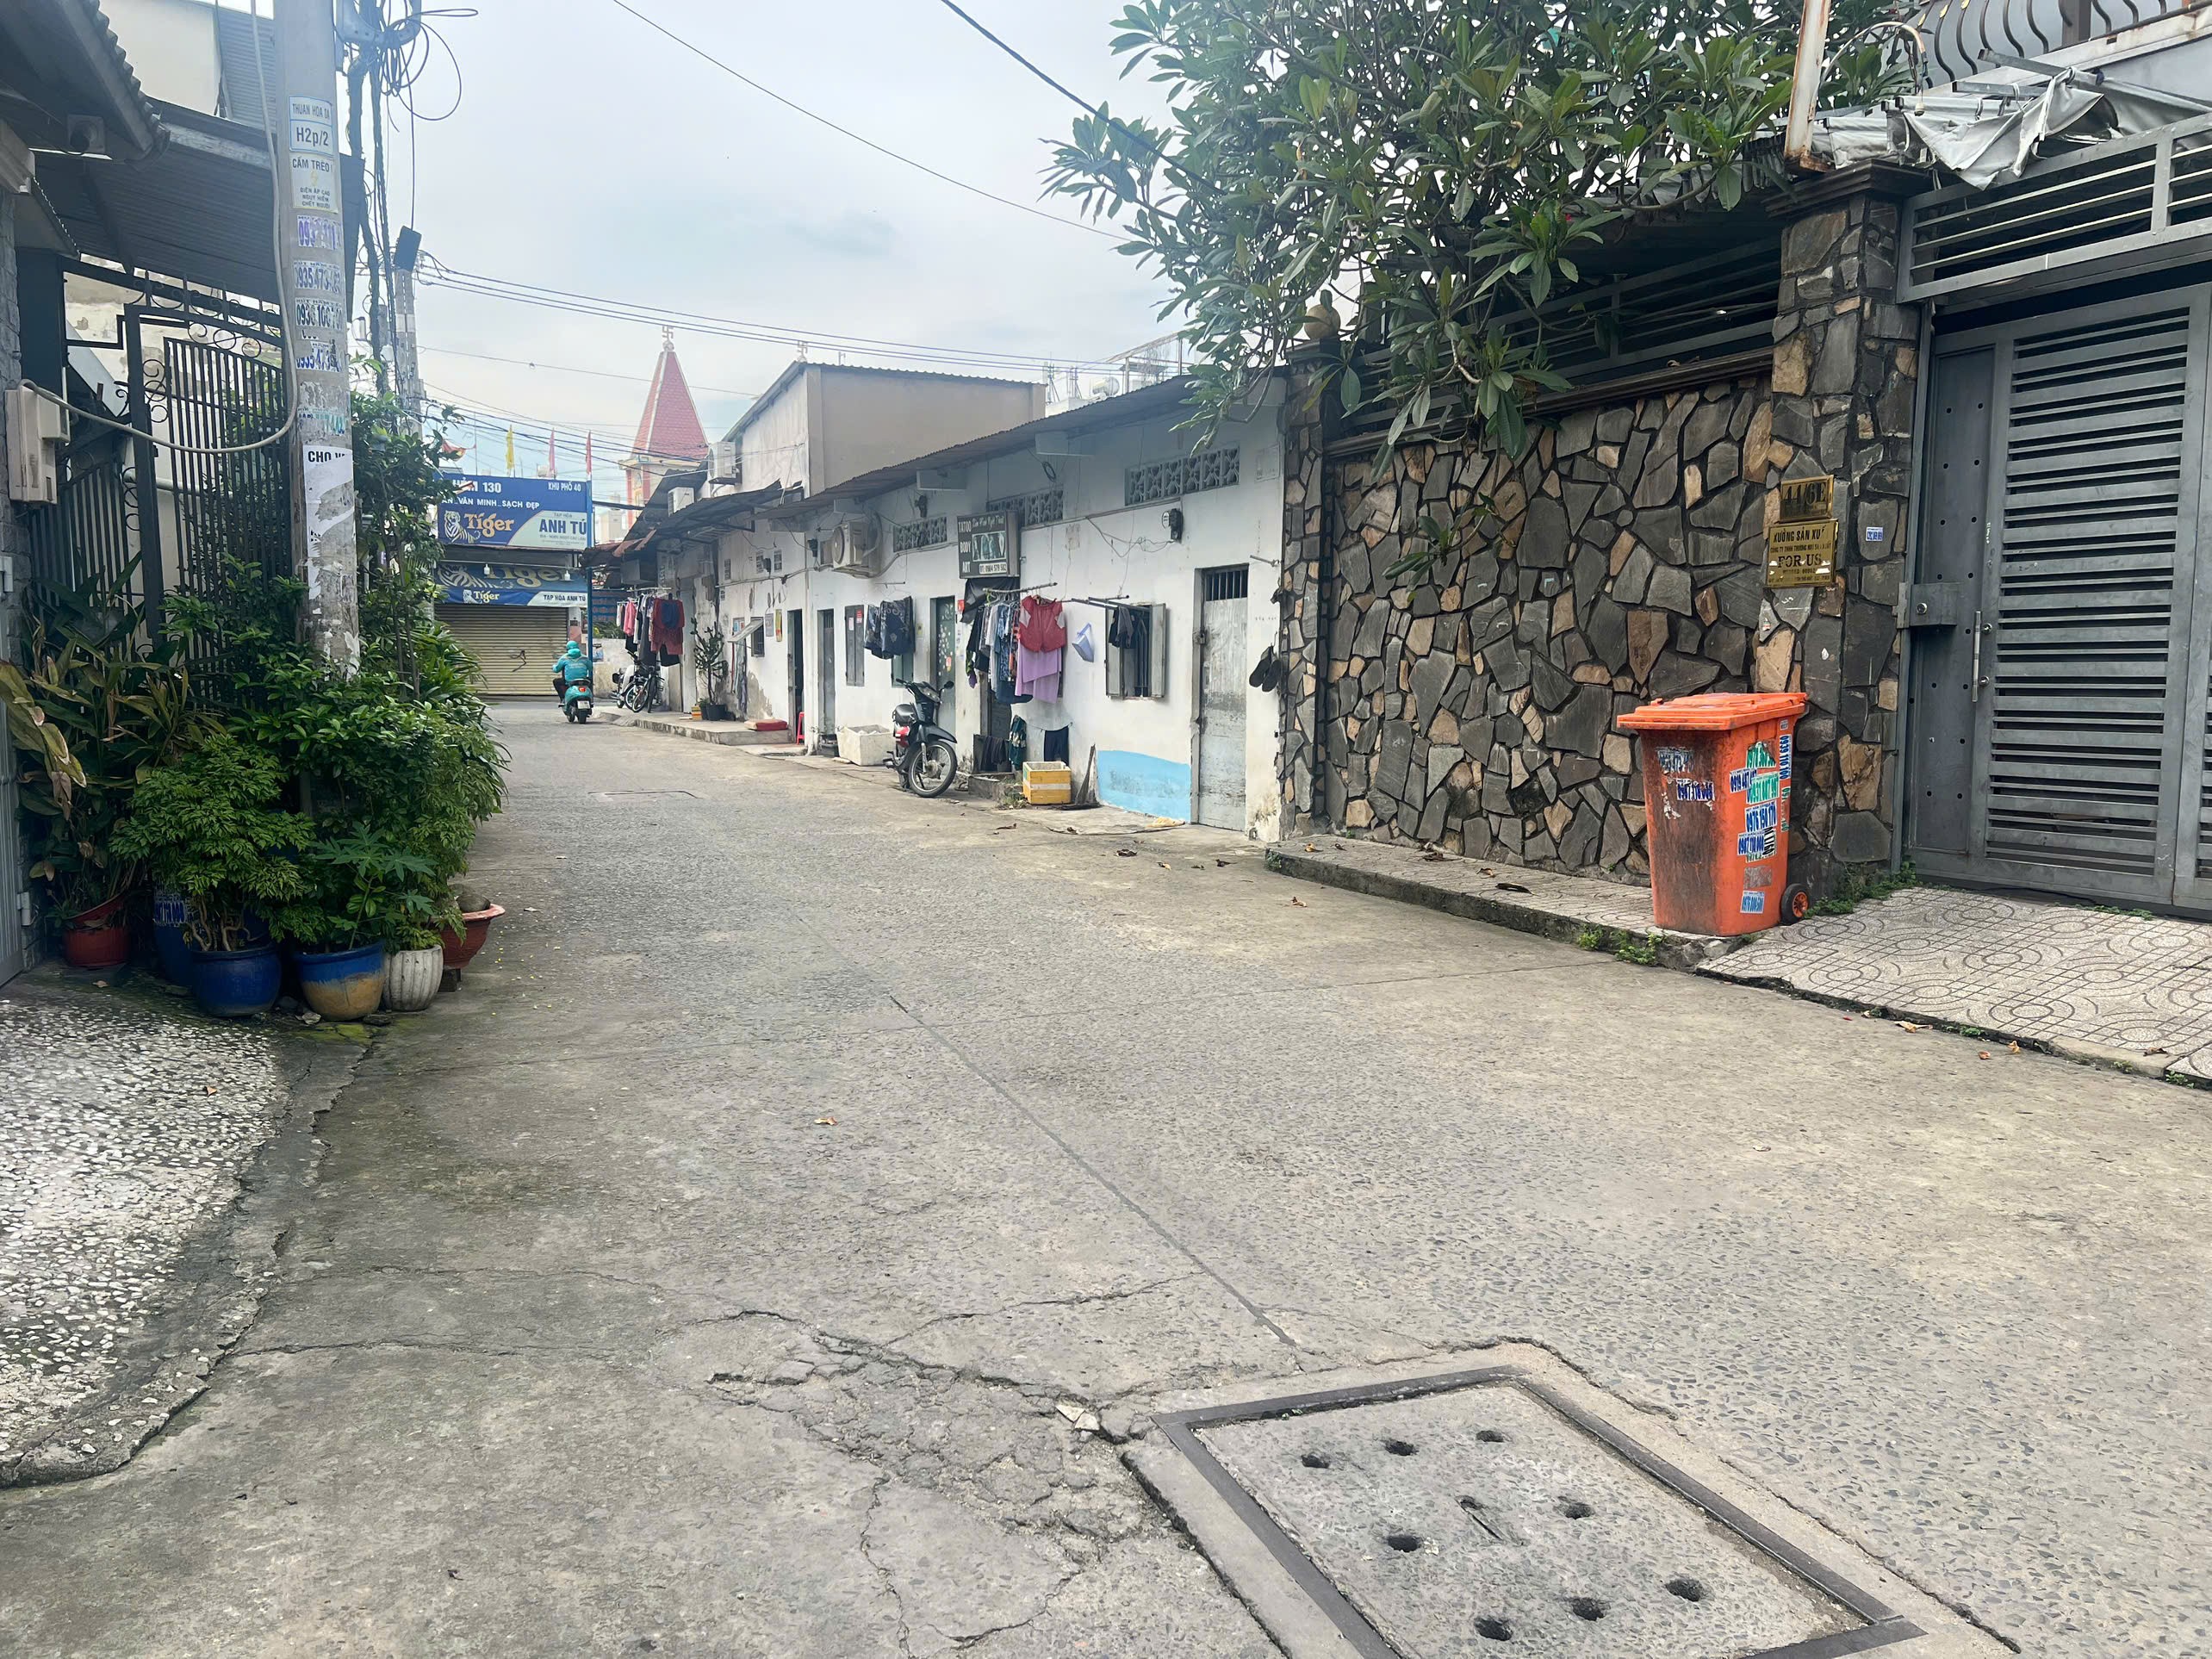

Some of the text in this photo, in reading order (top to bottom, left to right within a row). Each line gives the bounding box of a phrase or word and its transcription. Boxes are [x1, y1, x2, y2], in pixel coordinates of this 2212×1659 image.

[296, 127, 328, 147] H2p/2
[293, 155, 330, 172] CẤM TREO
[482, 482, 501, 494] 130
[548, 481, 581, 492] KHU PHỐ 40
[525, 501, 540, 511] ĐẸP
[463, 512, 515, 538] Tiger
[539, 519, 587, 535] ANH TÚ
[960, 541, 972, 553] BODY
[1777, 553, 1823, 569] FOR US
[473, 590, 500, 601] Tiger
